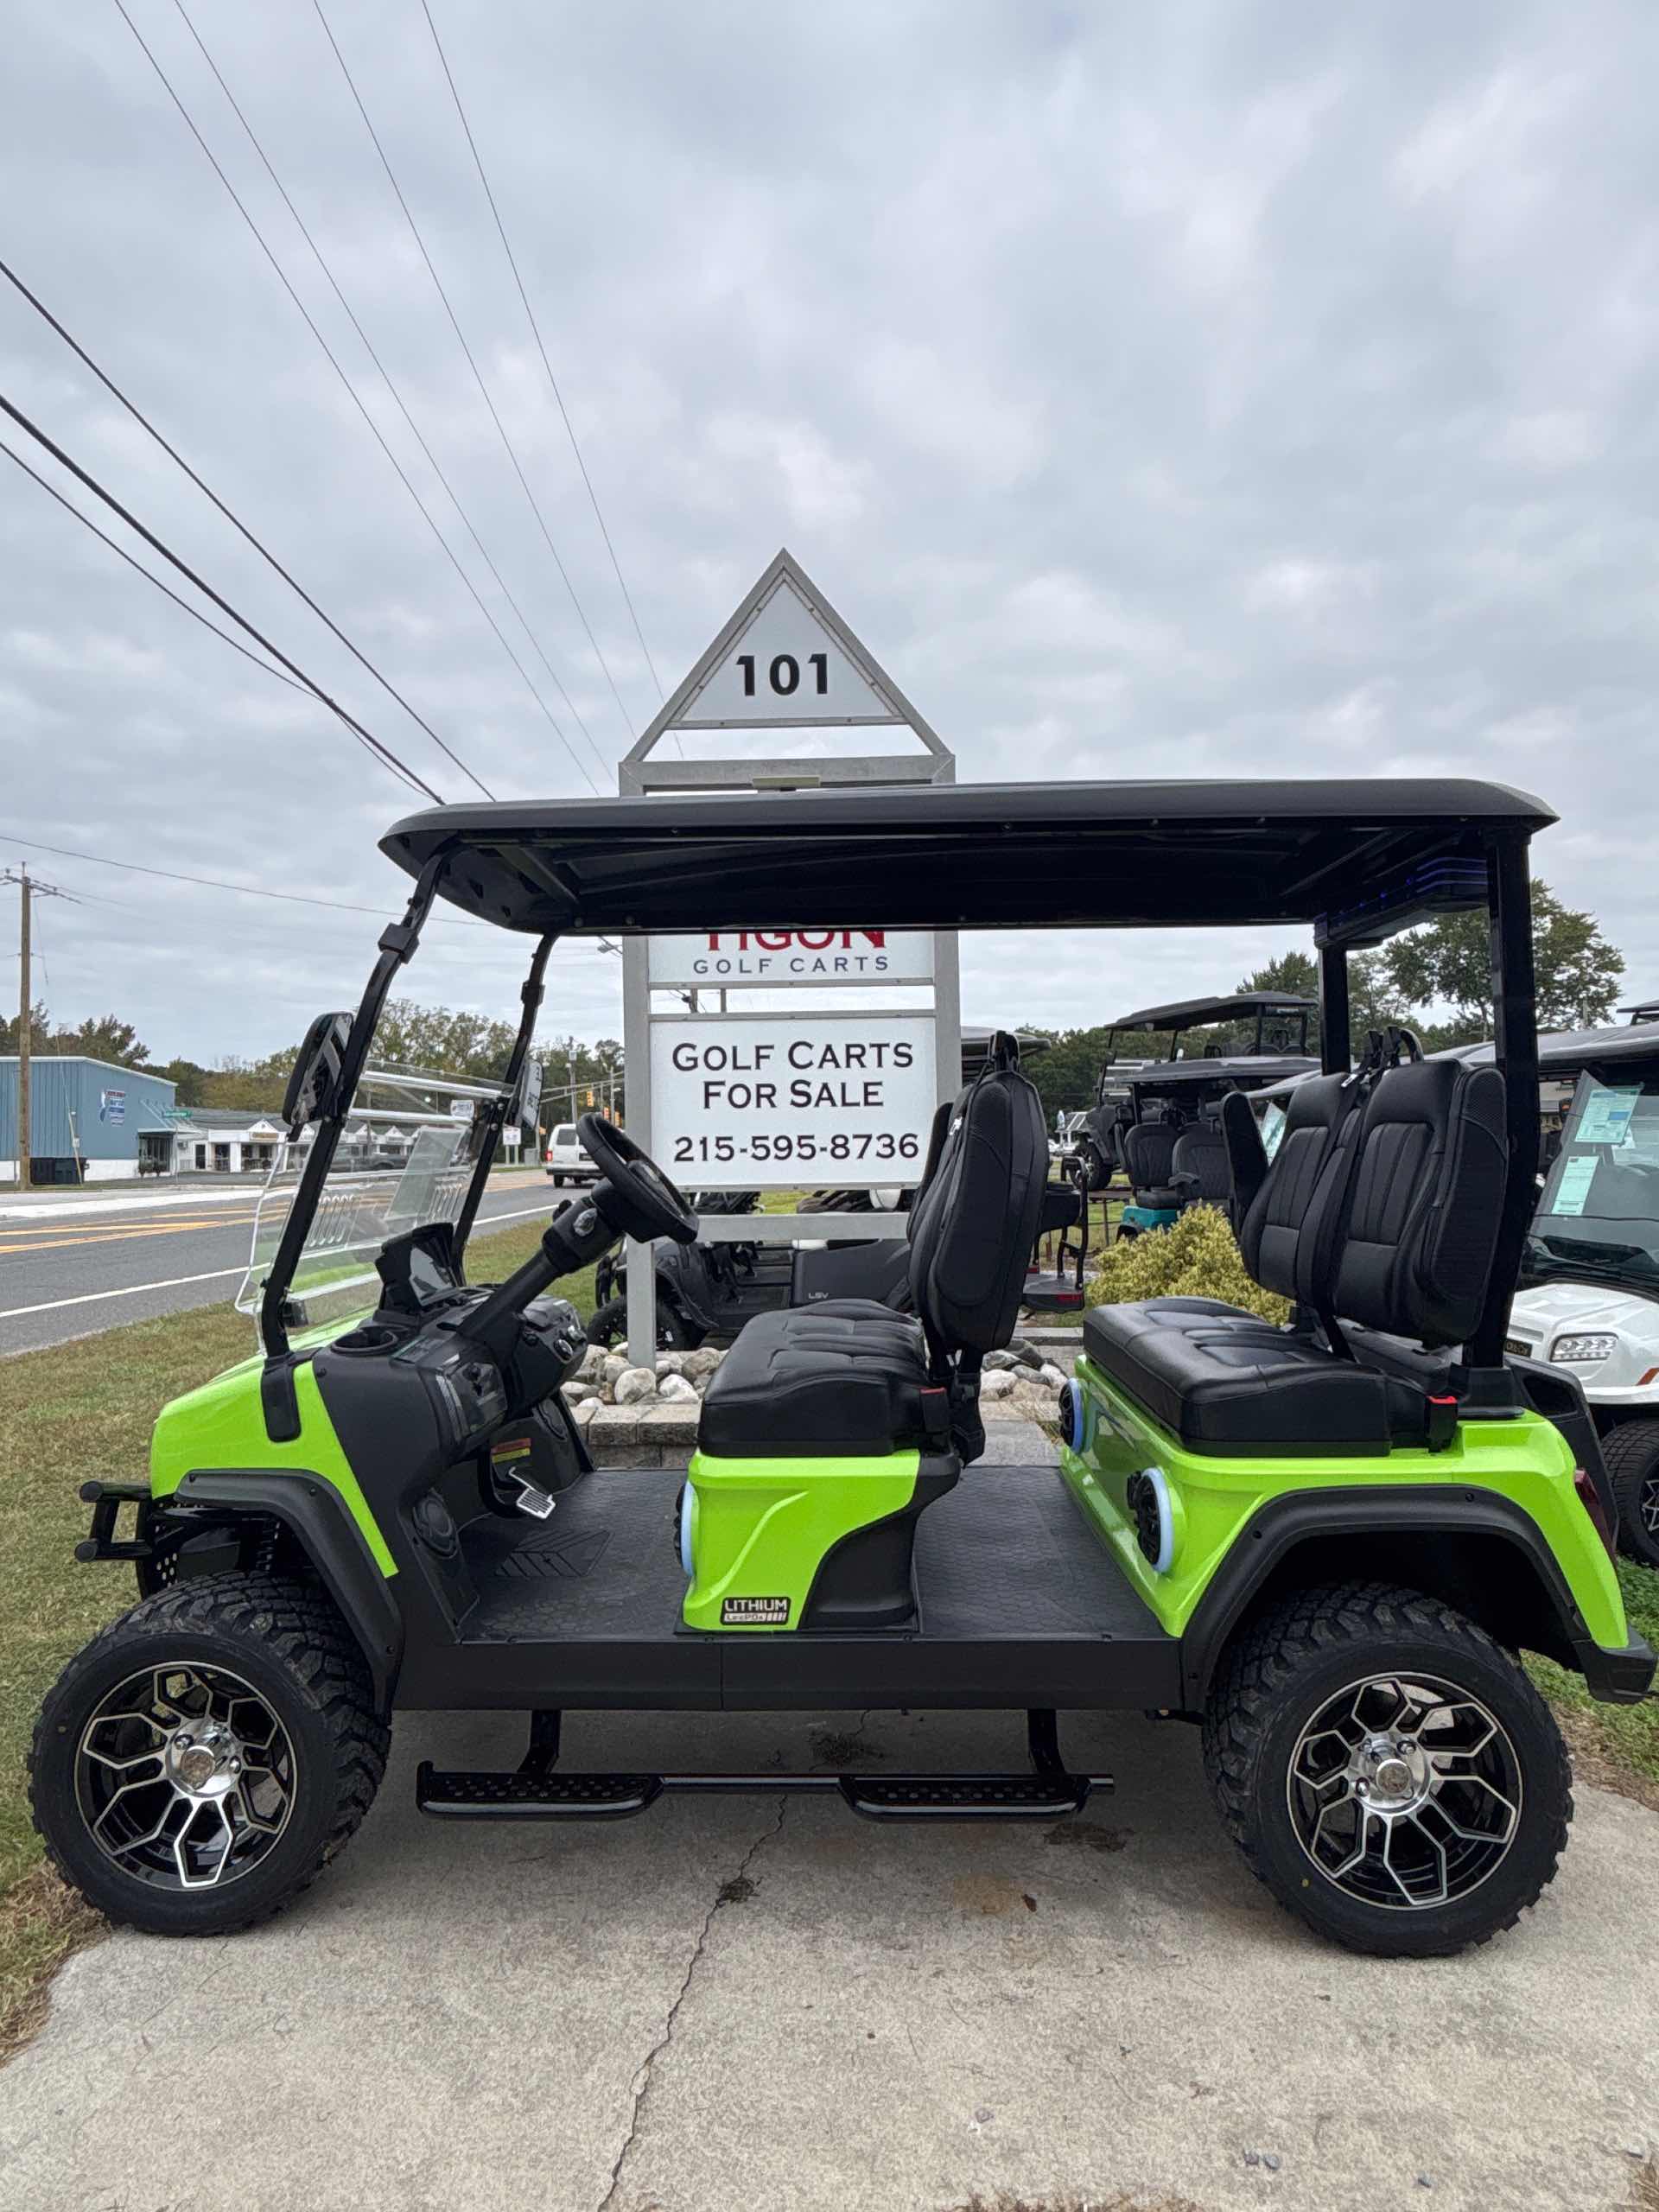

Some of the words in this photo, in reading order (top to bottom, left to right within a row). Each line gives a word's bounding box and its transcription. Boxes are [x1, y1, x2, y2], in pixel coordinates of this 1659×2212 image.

[735, 653, 828, 696] 101
[693, 958, 772, 974] GOLF
[790, 957, 888, 972] CARTS
[672, 1042, 775, 1071] GOLF
[788, 1040, 913, 1070] CARTS
[703, 1080, 777, 1109] FOR
[790, 1079, 884, 1108] SALE
[674, 1133, 919, 1162] 215-595-8736
[724, 1599, 787, 1611] LITHIUM
